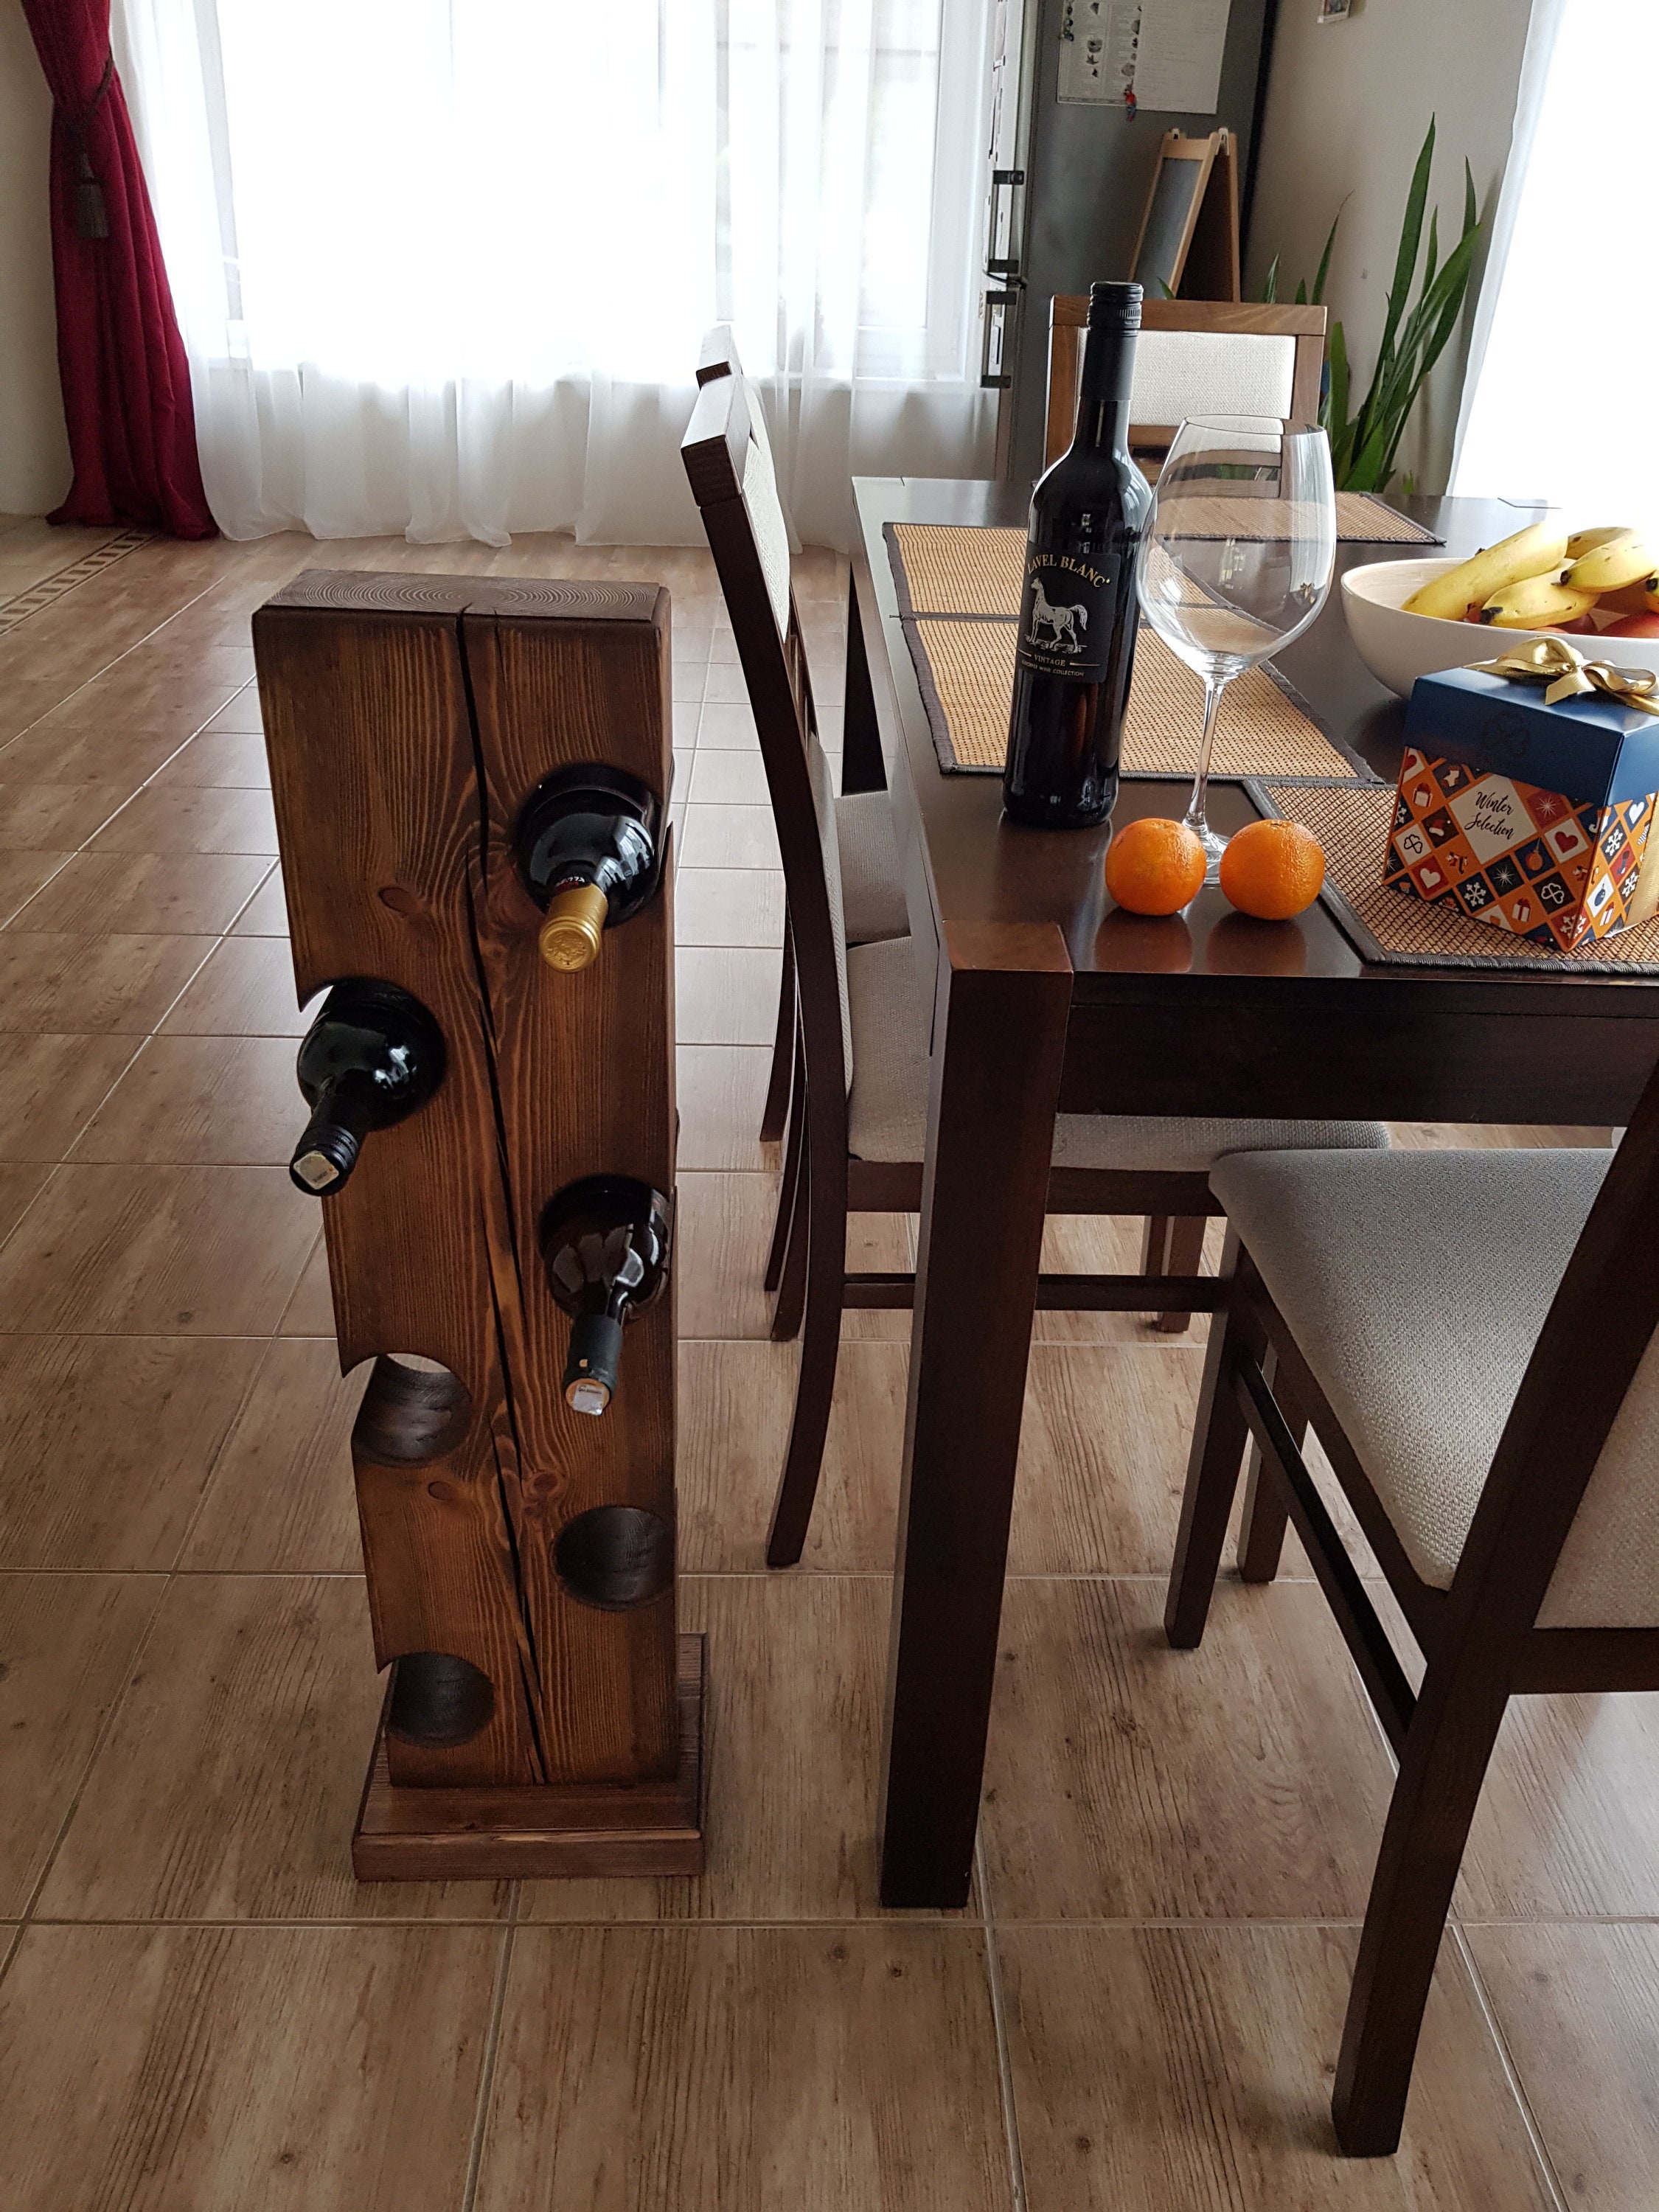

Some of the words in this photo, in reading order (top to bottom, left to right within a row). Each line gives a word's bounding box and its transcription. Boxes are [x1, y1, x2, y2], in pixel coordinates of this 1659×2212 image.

[1034, 654, 1065, 666] VINTAGE
[1475, 791, 1514, 815] Winter
[1464, 812, 1514, 840] Selection
